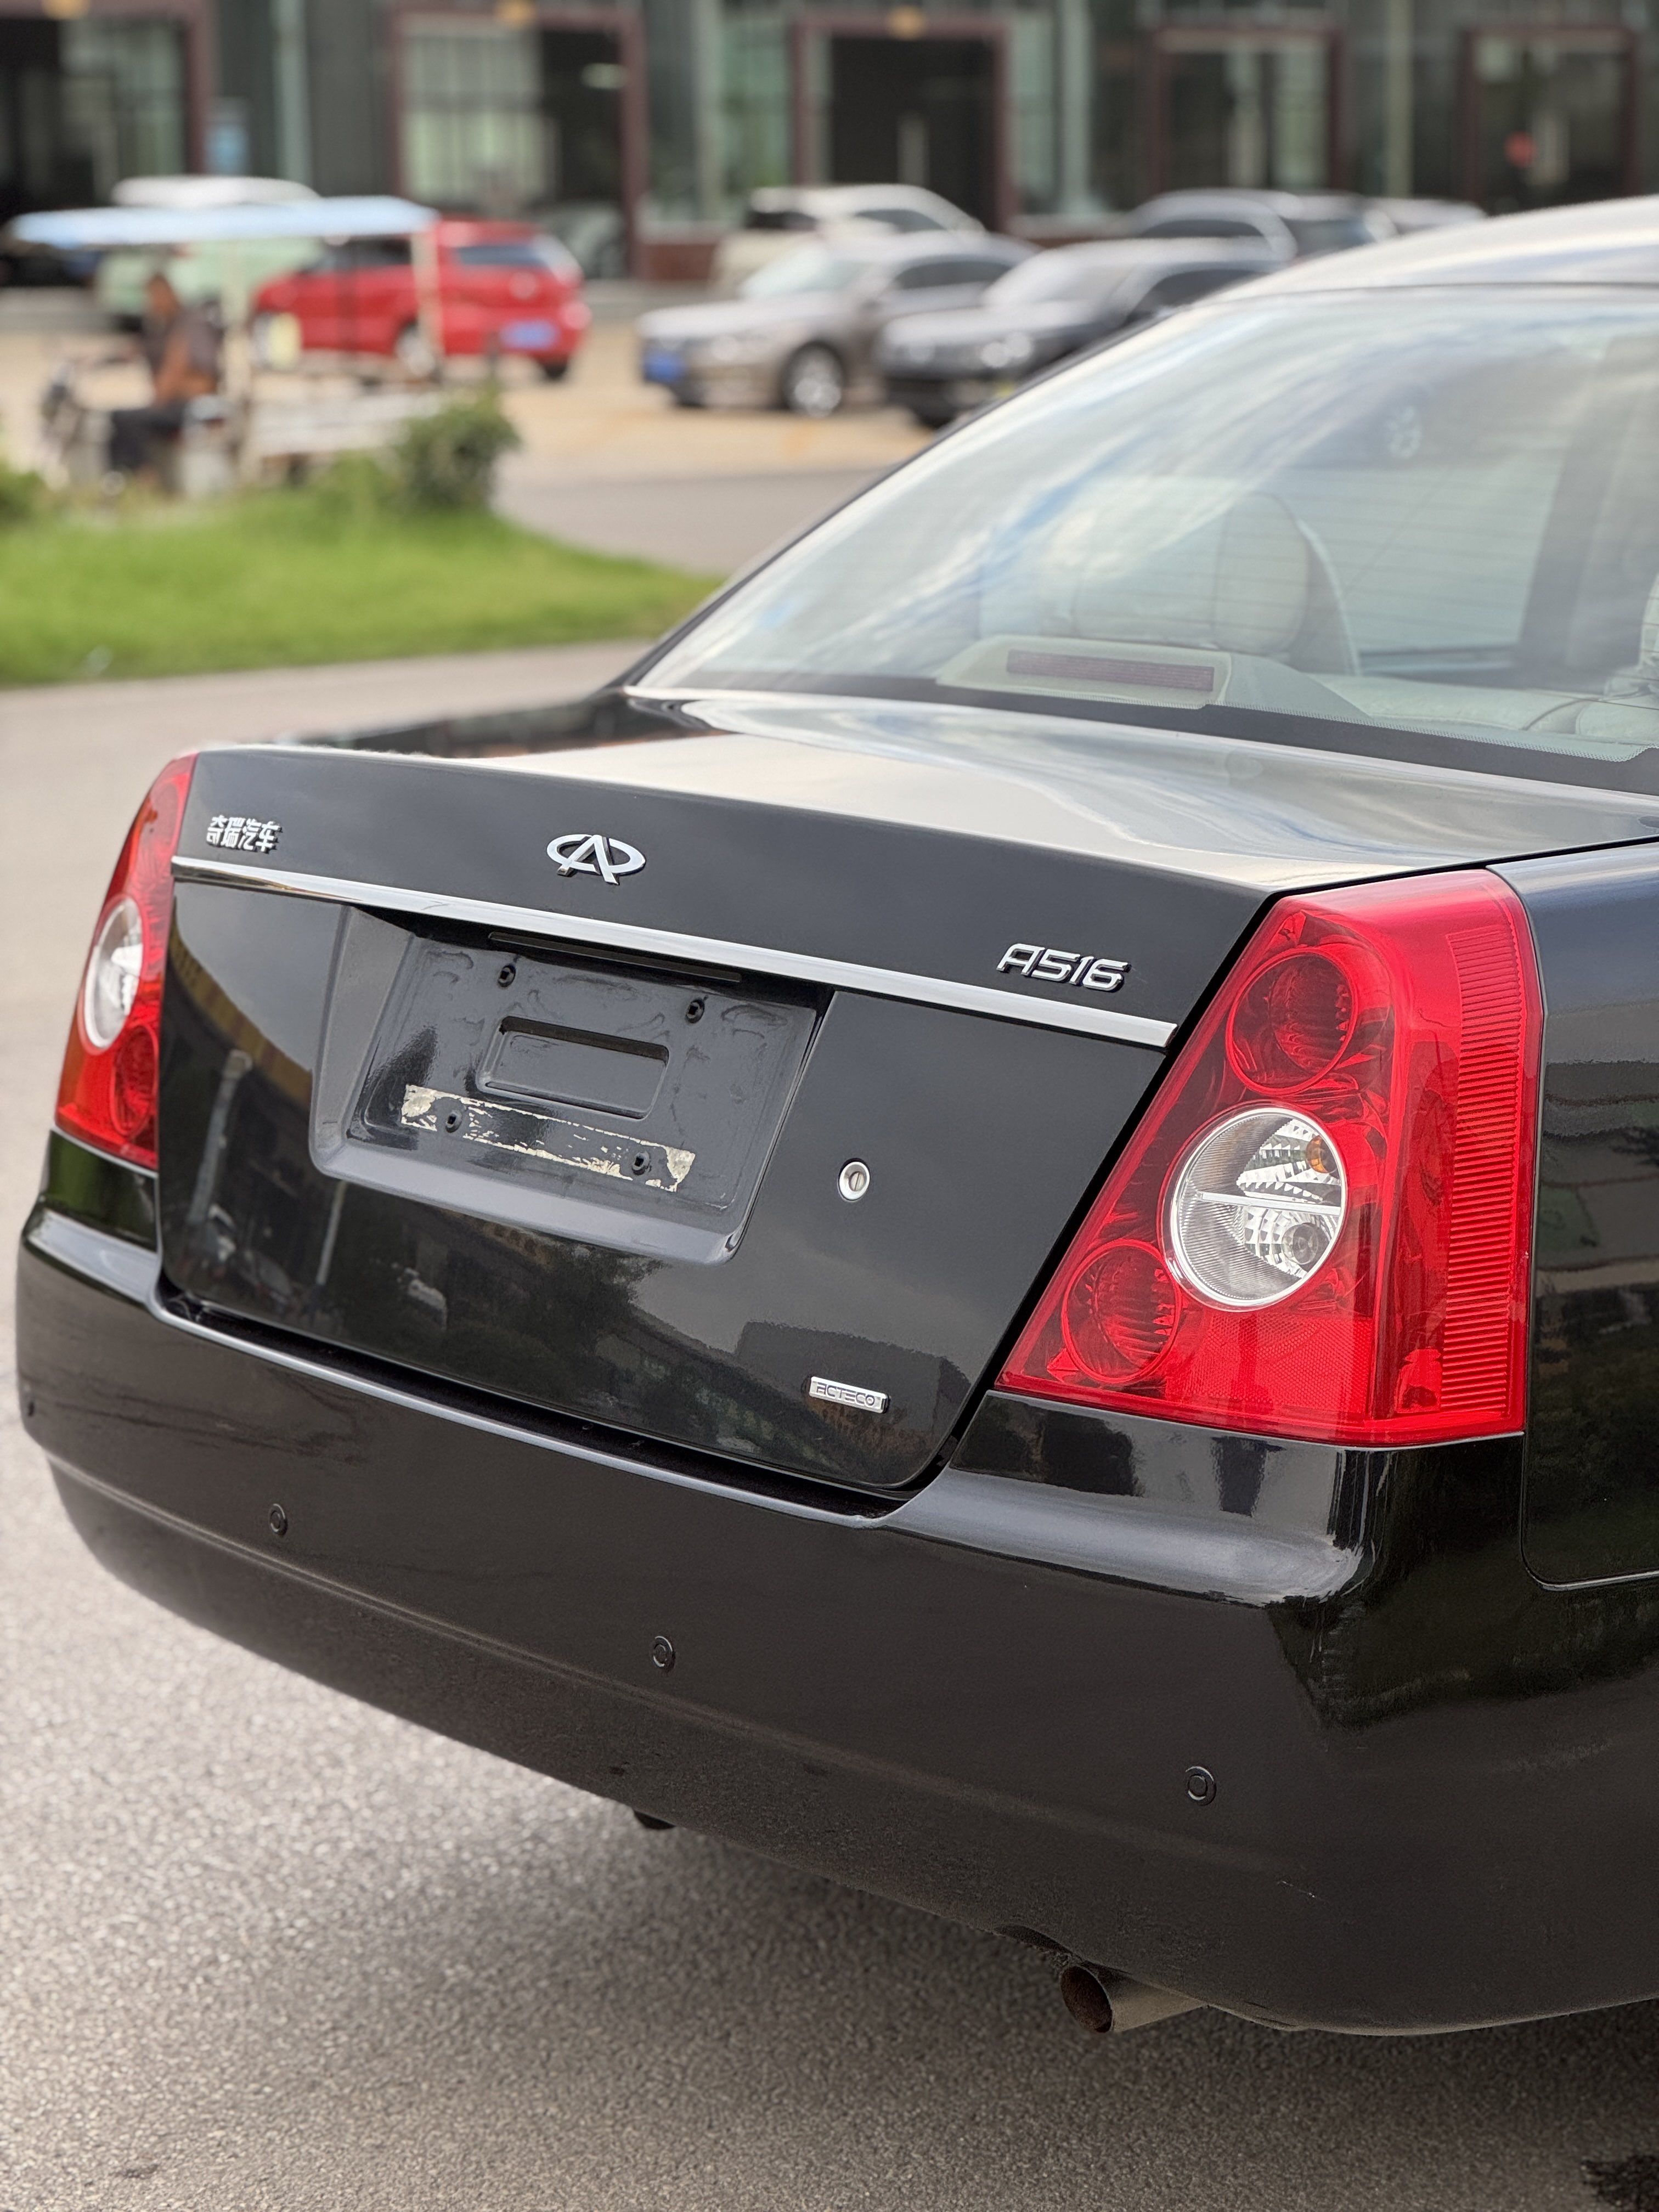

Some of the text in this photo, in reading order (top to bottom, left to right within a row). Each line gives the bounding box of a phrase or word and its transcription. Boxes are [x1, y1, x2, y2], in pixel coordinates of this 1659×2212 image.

[206, 815, 281, 852] 奇瑞汽车
[996, 943, 1130, 991] A516
[816, 1381, 876, 1407] ACTECO
